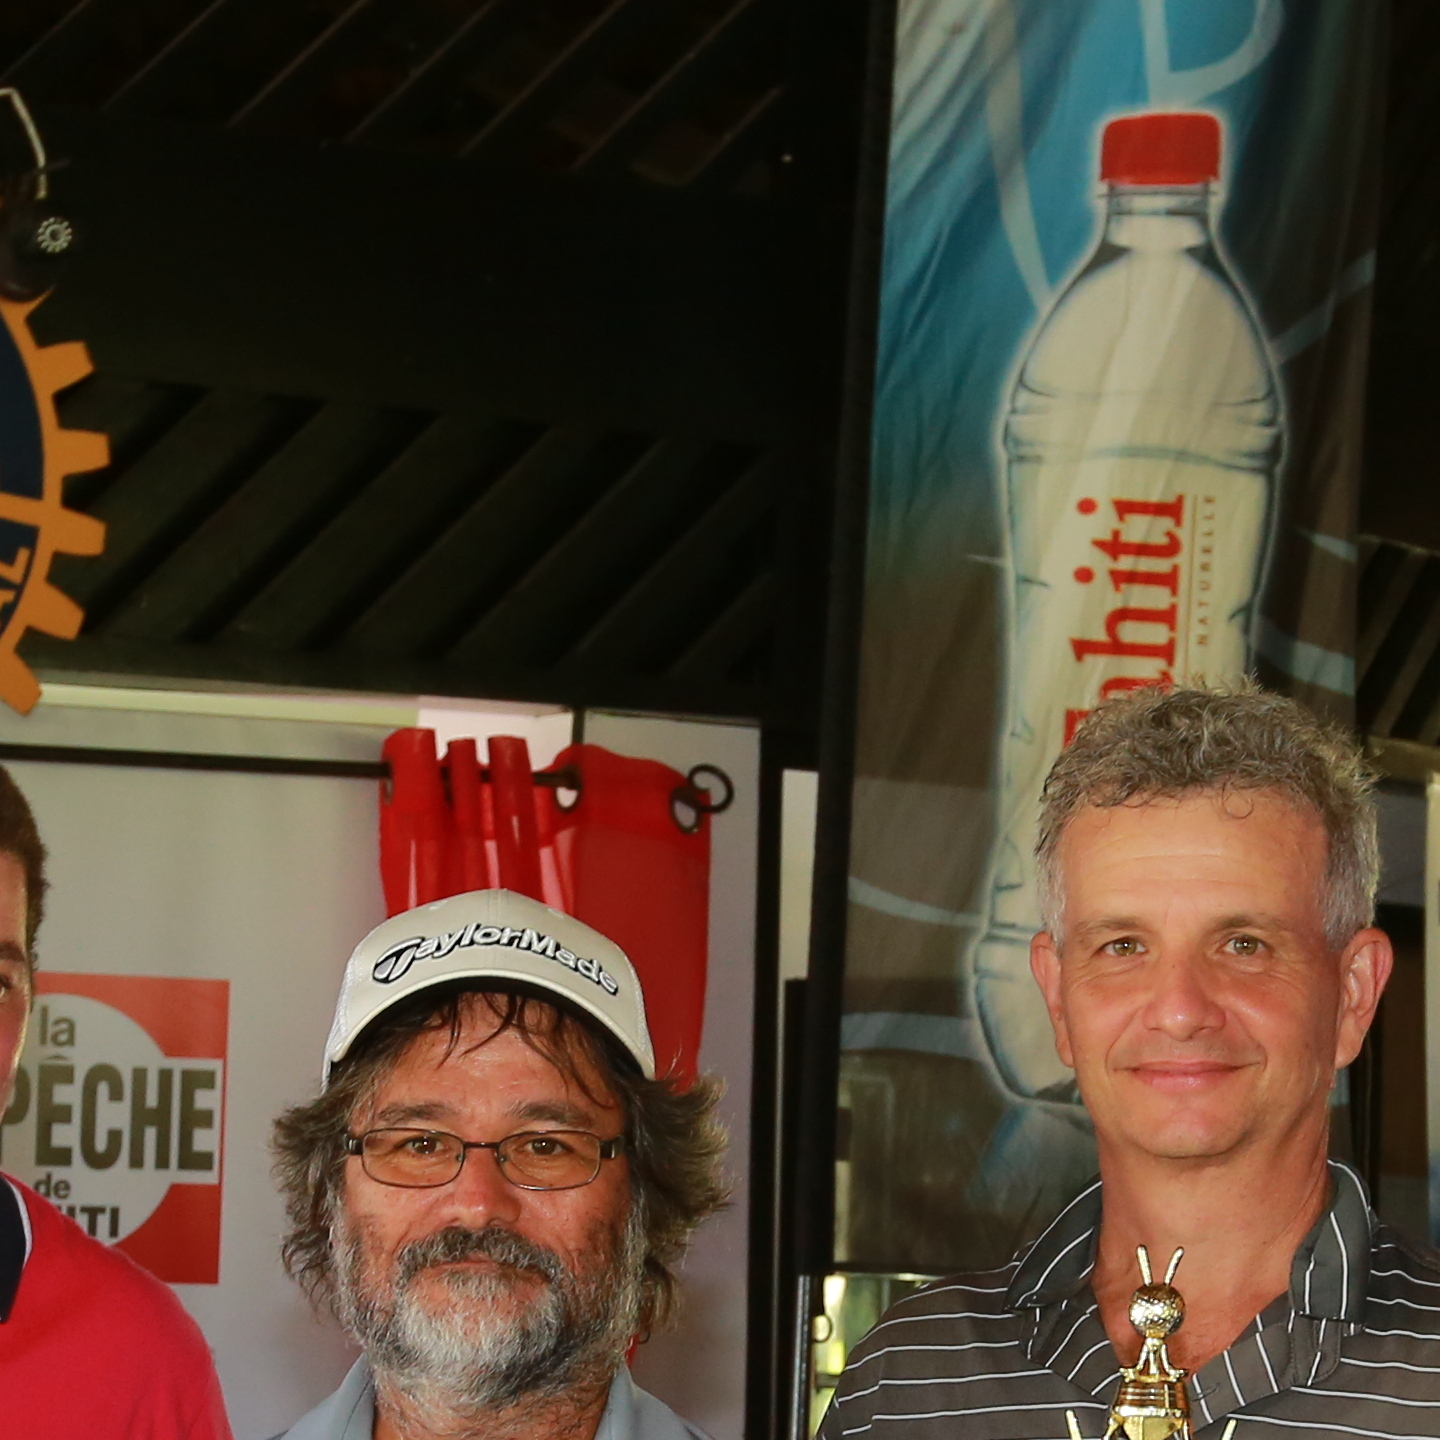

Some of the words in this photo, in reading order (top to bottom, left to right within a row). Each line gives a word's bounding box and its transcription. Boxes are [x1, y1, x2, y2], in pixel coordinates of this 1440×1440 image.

[372, 922, 618, 996] TaylorMade
[38, 1005, 77, 1048] la
[34, 1174, 72, 1200] de
